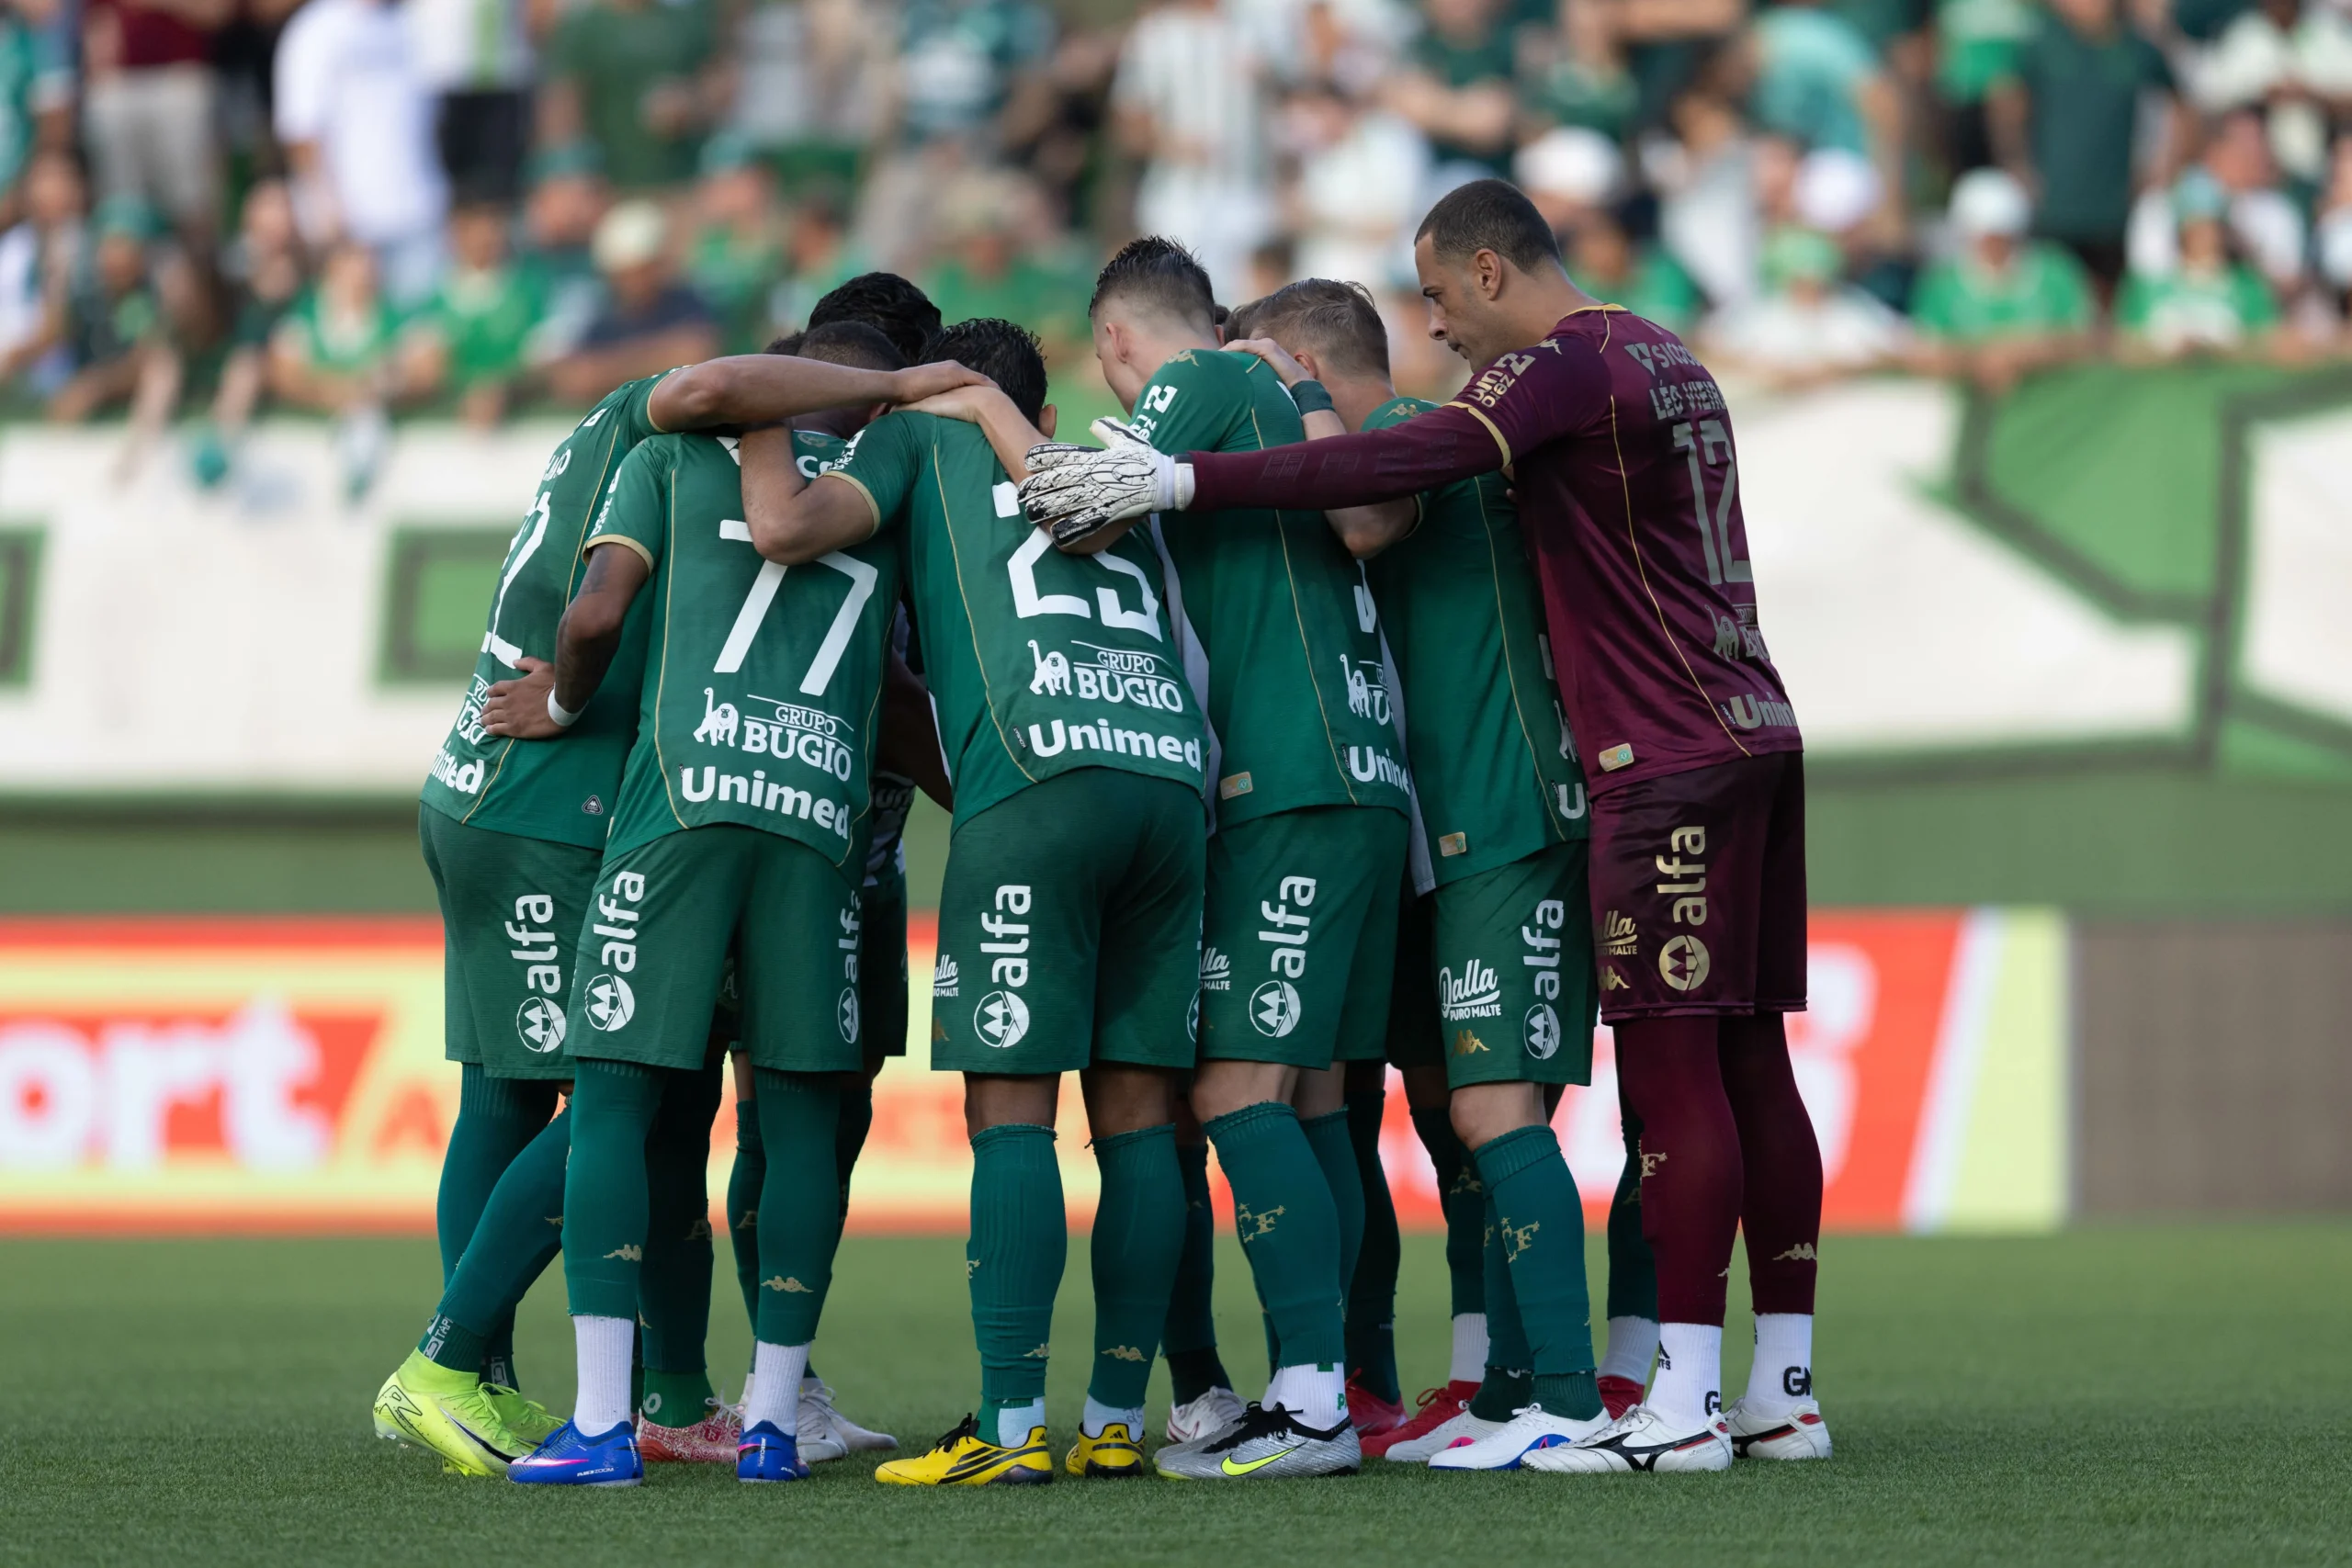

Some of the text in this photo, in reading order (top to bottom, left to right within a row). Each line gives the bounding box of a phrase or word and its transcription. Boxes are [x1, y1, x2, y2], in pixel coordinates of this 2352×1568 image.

[1672, 419, 1753, 586] 12
[713, 519, 878, 696] 77
[1078, 667, 1184, 713] BUGIO
[1097, 651, 1156, 675] GRUPO
[741, 719, 852, 783] BUGIO
[775, 705, 836, 736] GRUPO
[1028, 717, 1202, 773] Unimed
[681, 764, 849, 840] Unimed
[1656, 826, 1707, 926] alfa
[505, 894, 561, 994] alfa
[594, 870, 646, 973] alfa
[980, 885, 1032, 987] alfa
[1258, 875, 1317, 978] alfa
[1521, 899, 1564, 1000] alfa
[1439, 958, 1498, 1019] Dalla
[1450, 1004, 1502, 1021] PURO MALTE
